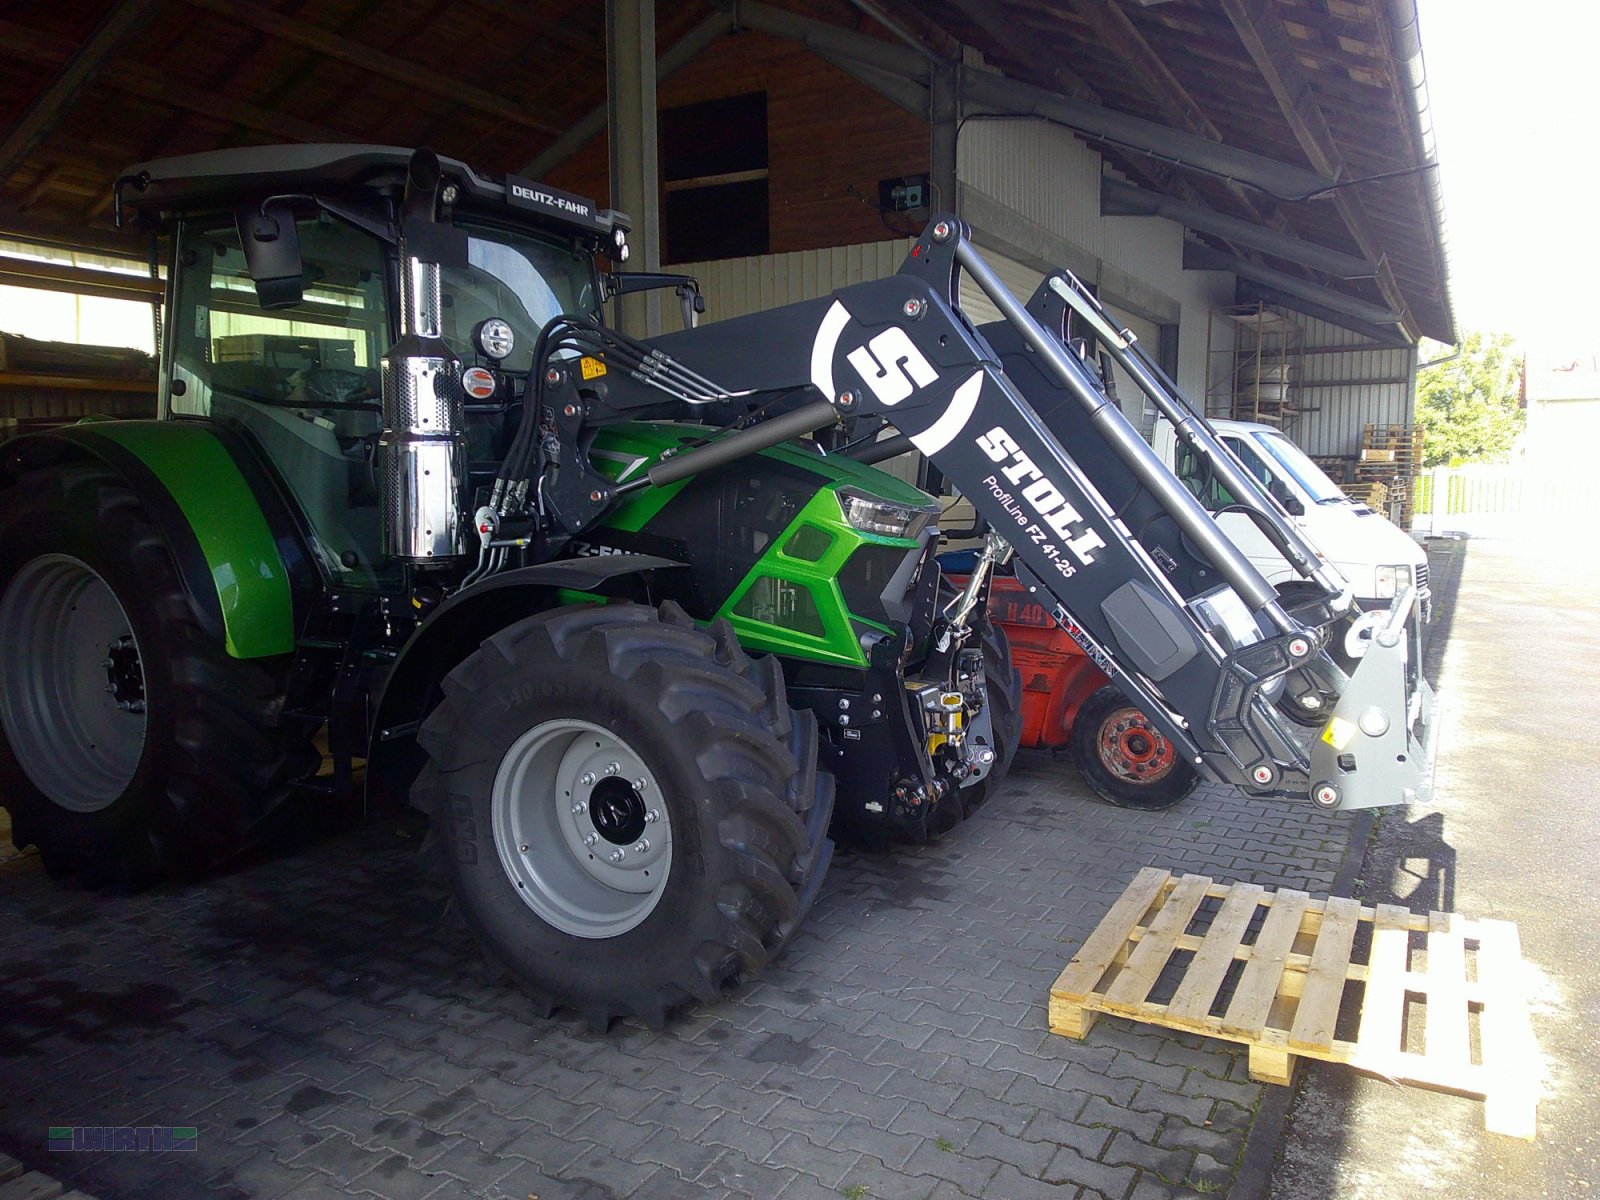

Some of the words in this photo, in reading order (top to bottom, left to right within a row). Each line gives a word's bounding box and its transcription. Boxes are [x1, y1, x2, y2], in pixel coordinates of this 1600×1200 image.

[512, 184, 589, 216] DEUTZ-FAHR
[846, 326, 940, 406] S
[975, 426, 1107, 566] STOLL
[982, 475, 1028, 526] ProfiLine
[1025, 524, 1047, 544] FZ
[1042, 543, 1077, 578] 41-25
[1020, 603, 1043, 623] 40
